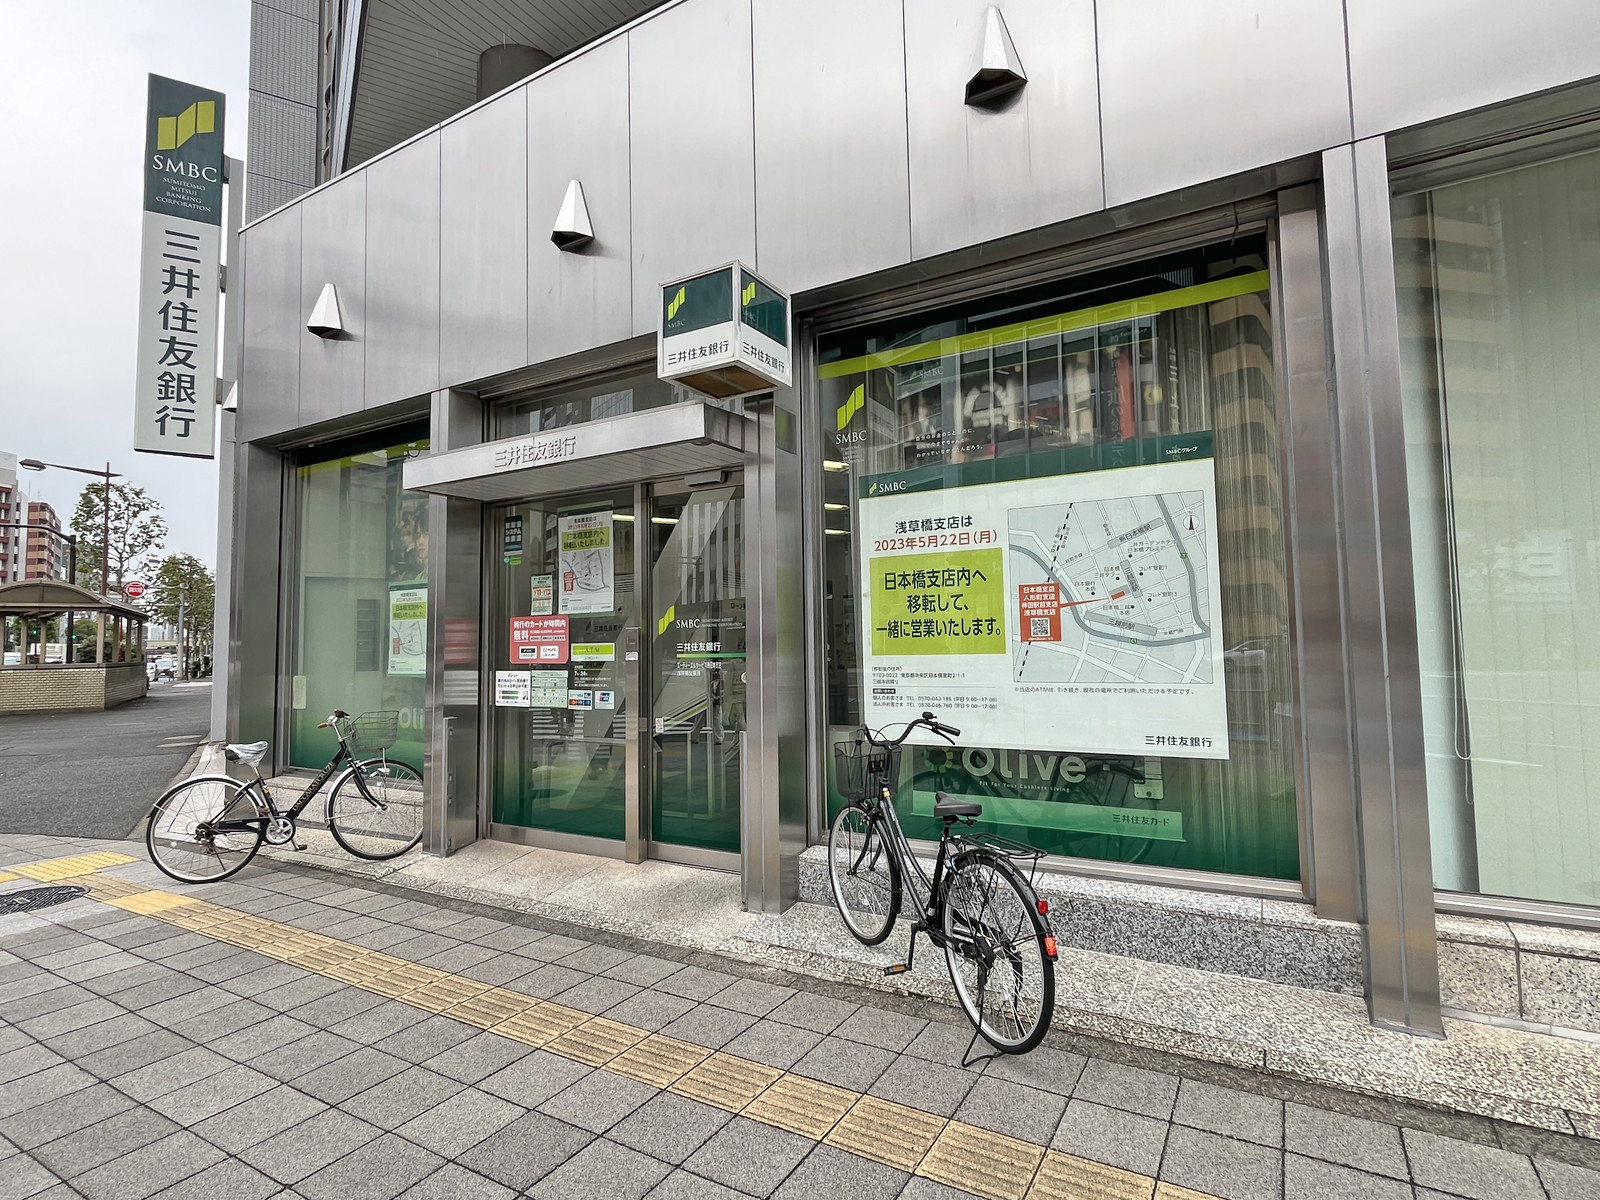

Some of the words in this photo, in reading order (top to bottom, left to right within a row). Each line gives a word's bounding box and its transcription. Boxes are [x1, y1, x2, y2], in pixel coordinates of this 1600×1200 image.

[152, 154, 217, 183] SMBC
[163, 177, 206, 191] SUMITOMO
[171, 186, 197, 196] MITSUI
[155, 196, 211, 212] CORPORATION
[166, 191, 202, 204] BANKING
[155, 230, 201, 438] 三井住友銀行
[668, 340, 729, 365] 三井住友銀行
[742, 341, 785, 373] 三井住友銀行
[835, 431, 867, 445] SMBC
[495, 436, 576, 468] 三井住友銀行
[1165, 446, 1198, 455] SMBCグループ
[879, 481, 906, 493] SMBC
[505, 528, 522, 536] システム
[895, 515, 973, 534] 浅草橋支店は
[874, 530, 998, 551] 2023年5月22日(月)
[884, 567, 987, 590] 日本橋支店内へ
[907, 594, 969, 614] 移転して、
[676, 618, 700, 629] SMBC
[876, 617, 1001, 639] 一緒に営業いたします。
[513, 629, 529, 641] 無料
[676, 642, 721, 652] 三井住友銀行
[1145, 735, 1213, 747] 三井住友銀行
[961, 747, 1087, 784] Olive
[1112, 813, 1170, 827] 三井住友カード
